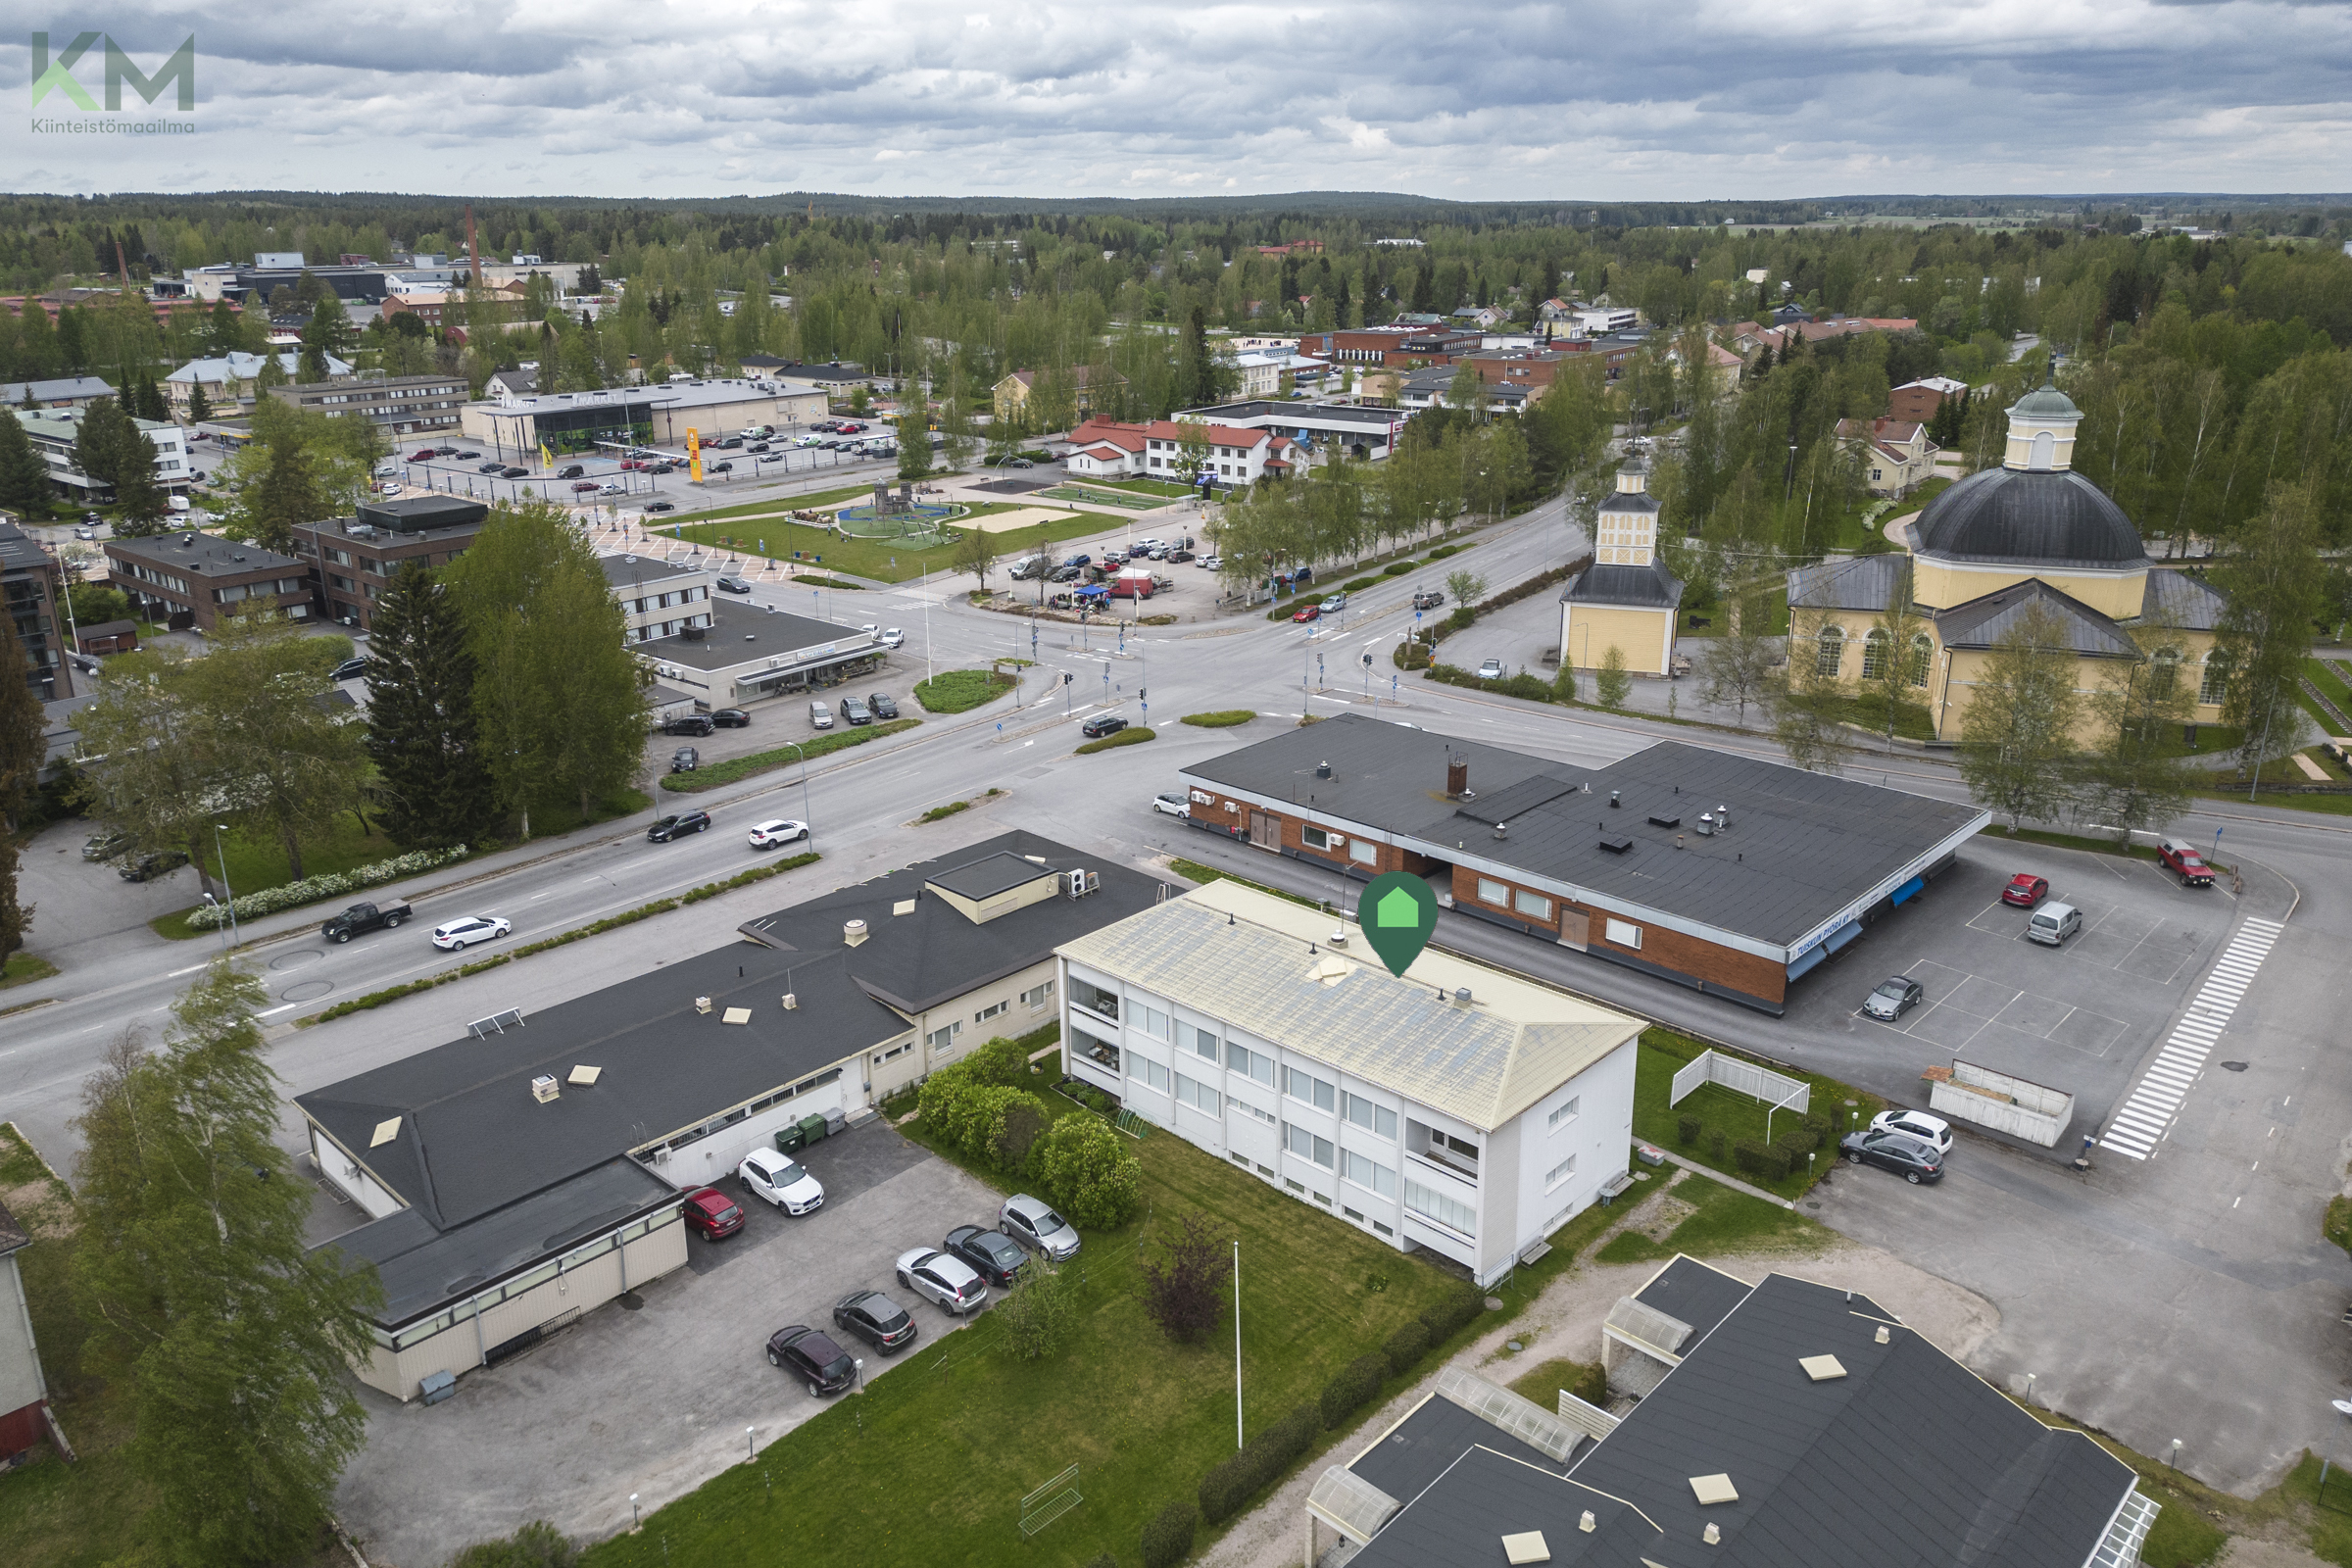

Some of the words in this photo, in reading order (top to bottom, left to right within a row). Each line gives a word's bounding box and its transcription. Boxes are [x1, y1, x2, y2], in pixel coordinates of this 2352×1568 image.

[506, 399, 535, 409] MARKET
[579, 394, 617, 406] MARKET
[1797, 933, 1823, 956] TUISKUN
[1842, 912, 1850, 925] KY
